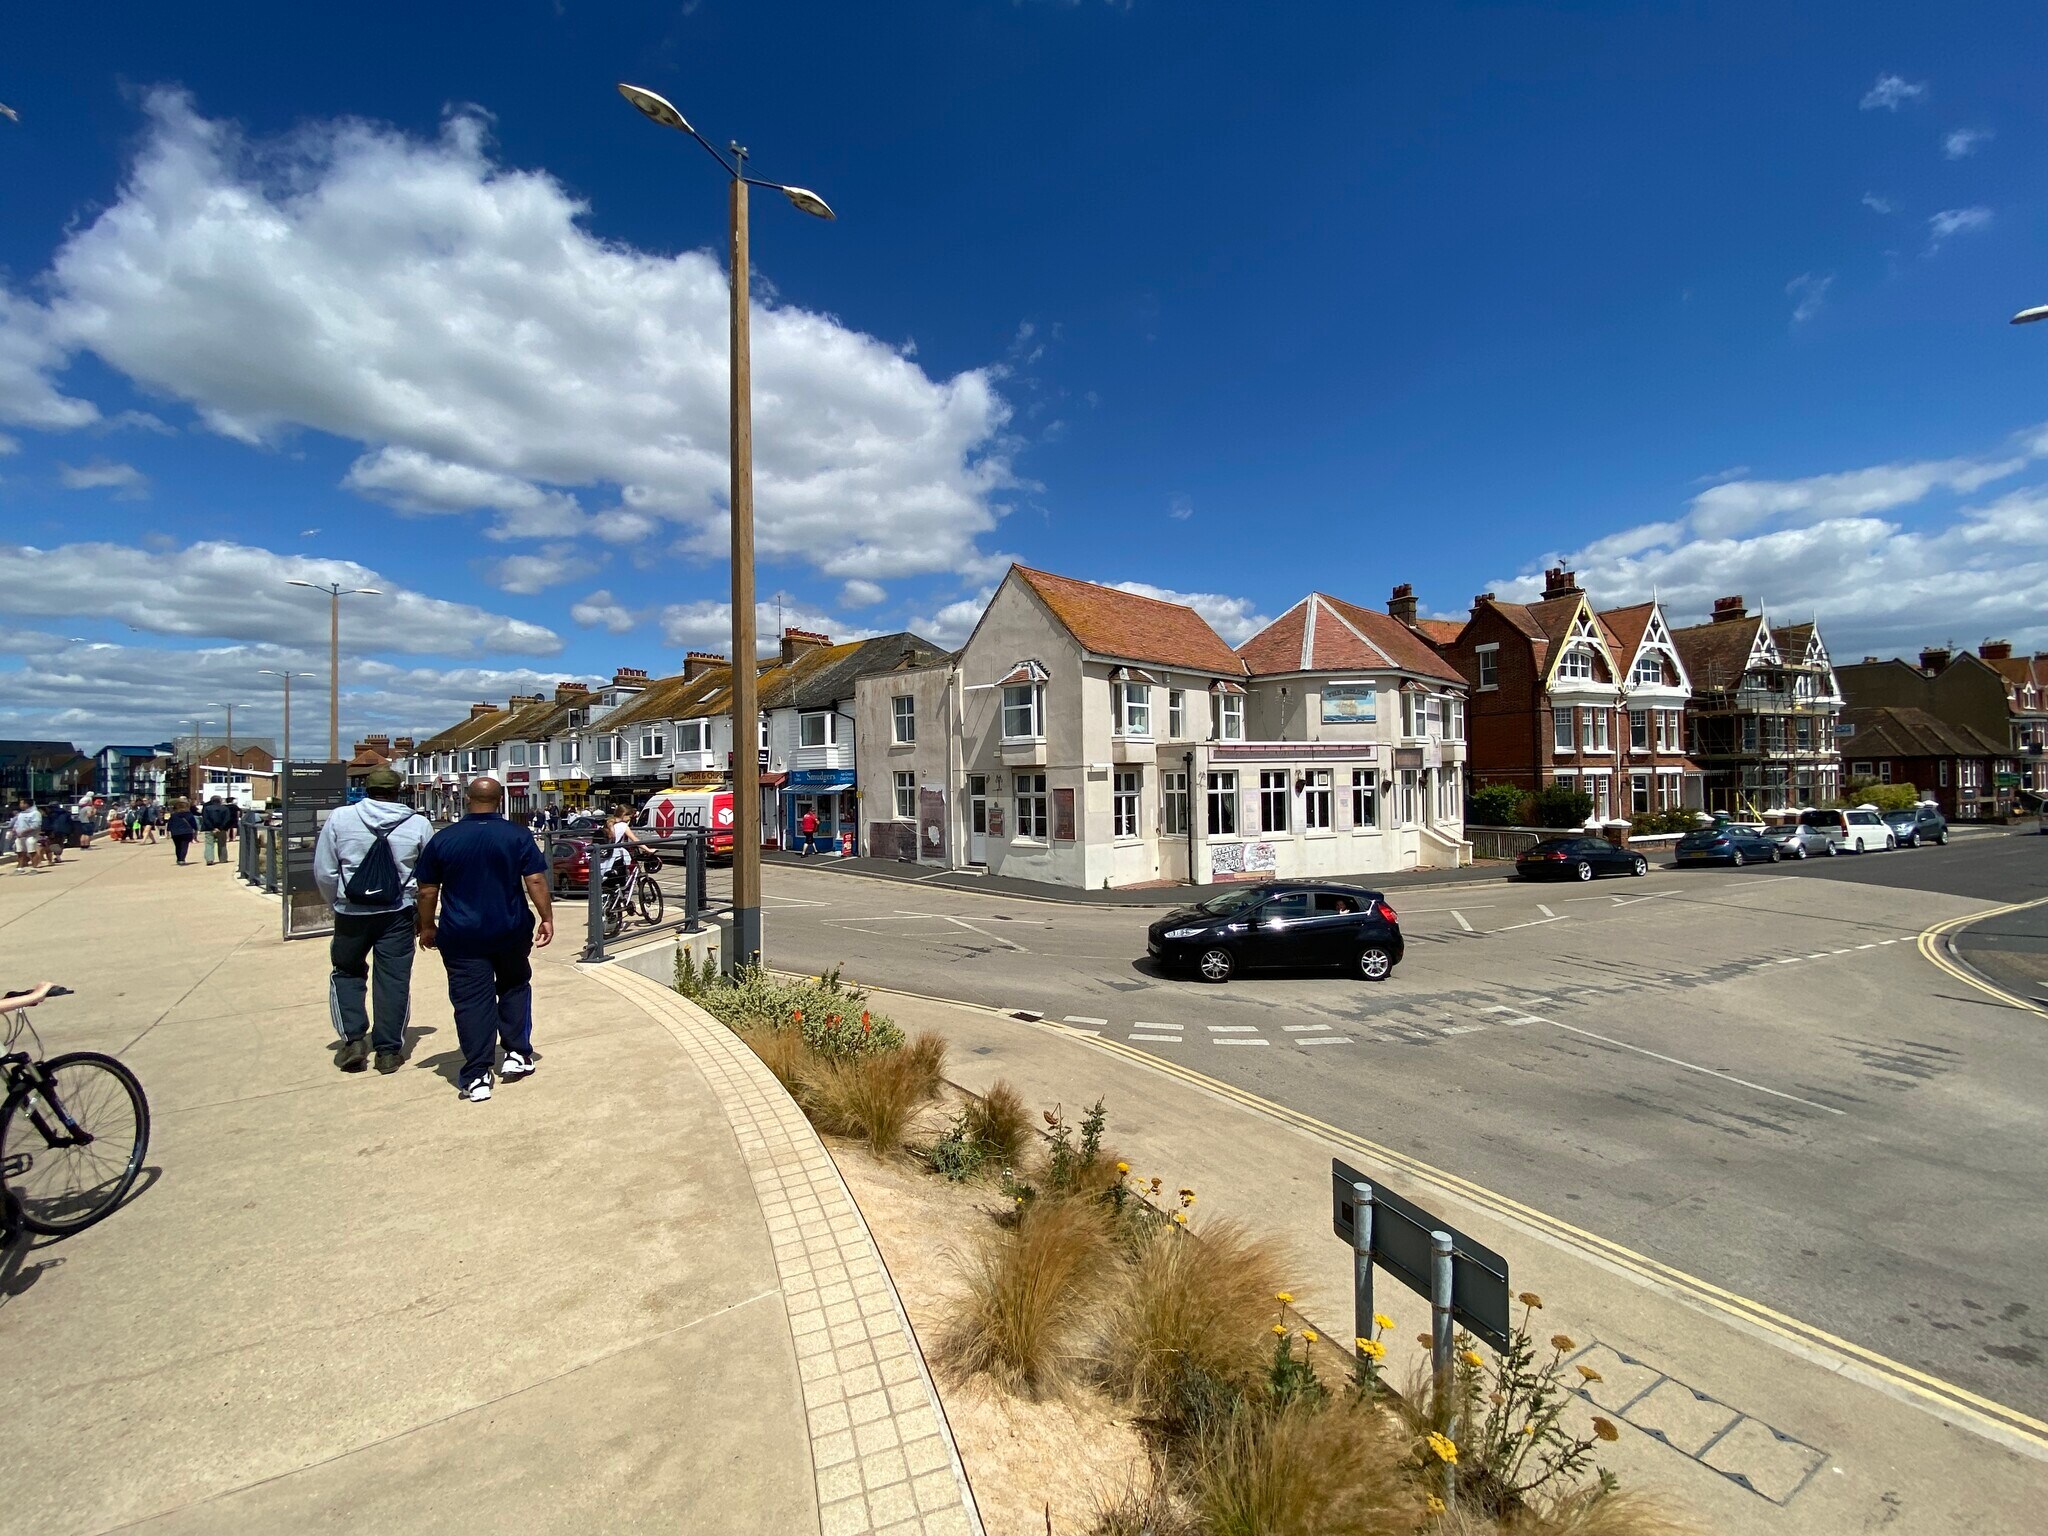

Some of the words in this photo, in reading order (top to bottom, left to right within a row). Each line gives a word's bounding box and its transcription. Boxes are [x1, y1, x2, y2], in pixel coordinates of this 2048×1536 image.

[689, 772, 700, 780] FISH
[807, 771, 836, 782] Smudgers
[678, 807, 701, 827] dpd
